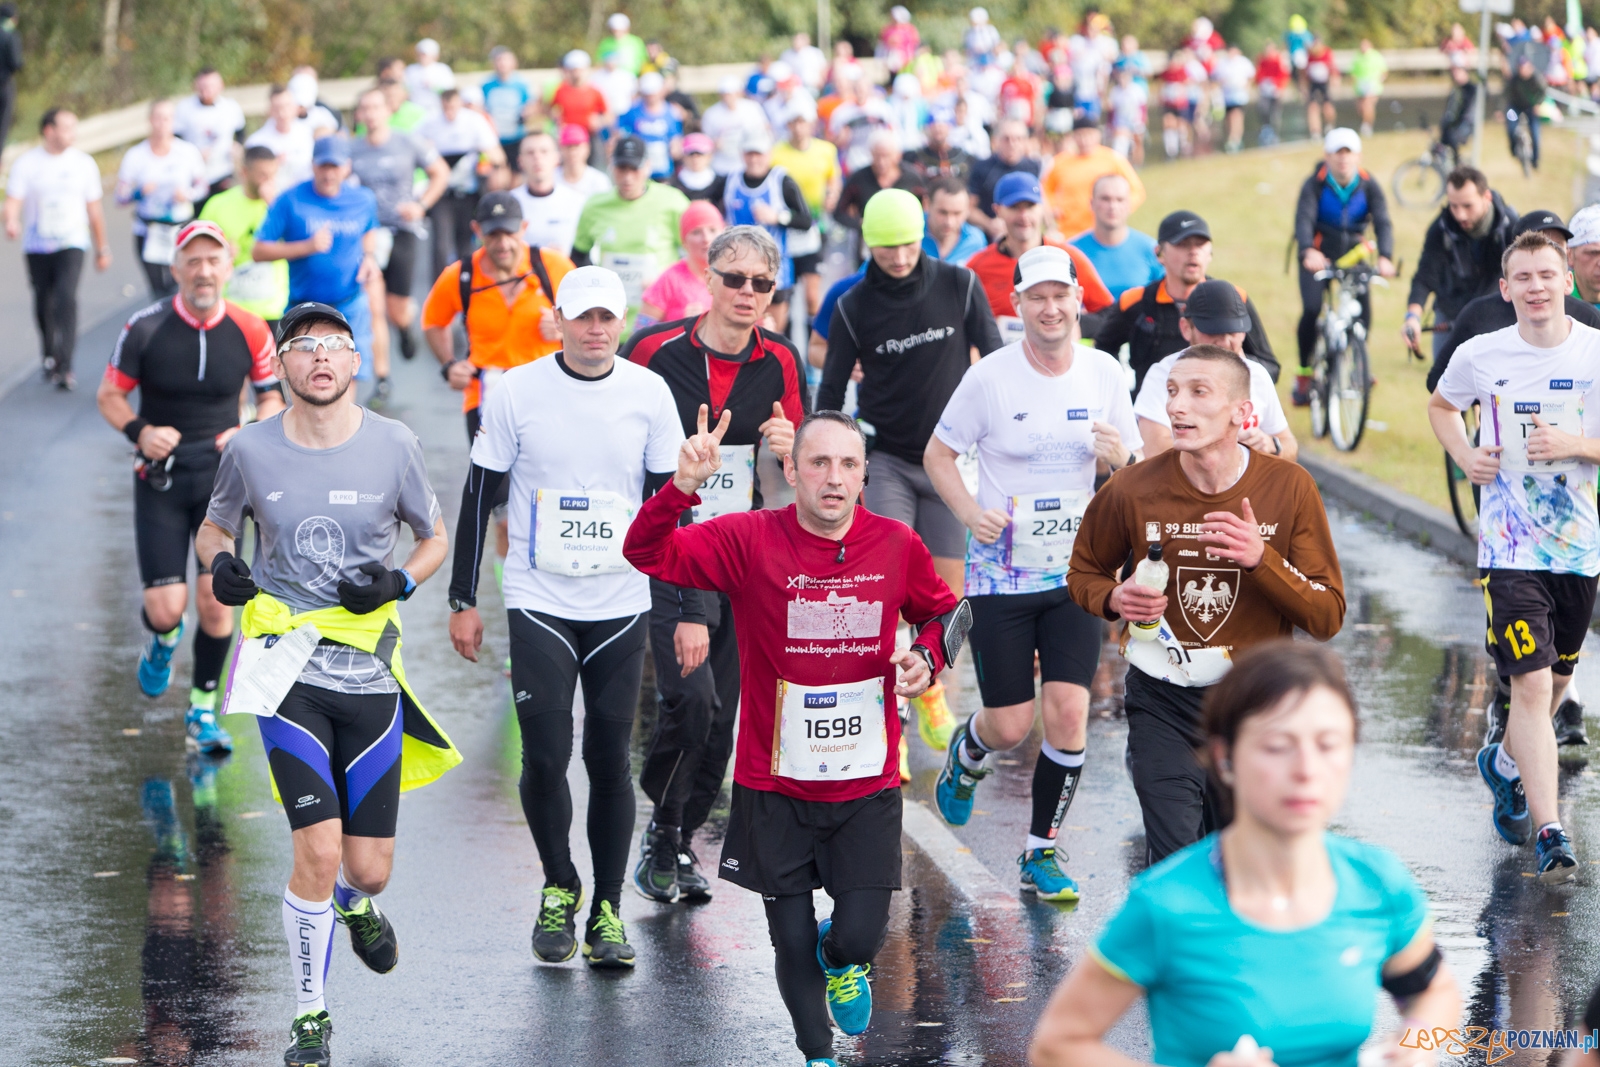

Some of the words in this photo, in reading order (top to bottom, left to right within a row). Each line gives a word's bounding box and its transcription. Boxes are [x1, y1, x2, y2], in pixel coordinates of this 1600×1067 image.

[1036, 441, 1088, 452] ODWAGA
[266, 491, 284, 502] 4F
[571, 500, 588, 508] PKO
[560, 520, 613, 539] 2146
[1032, 516, 1083, 536] 2248
[1165, 522, 1180, 535] 39
[295, 515, 346, 590] 9
[1504, 619, 1537, 661] 13
[818, 696, 836, 705] PKO
[804, 715, 862, 739] 1698
[809, 743, 858, 753] Waldemar
